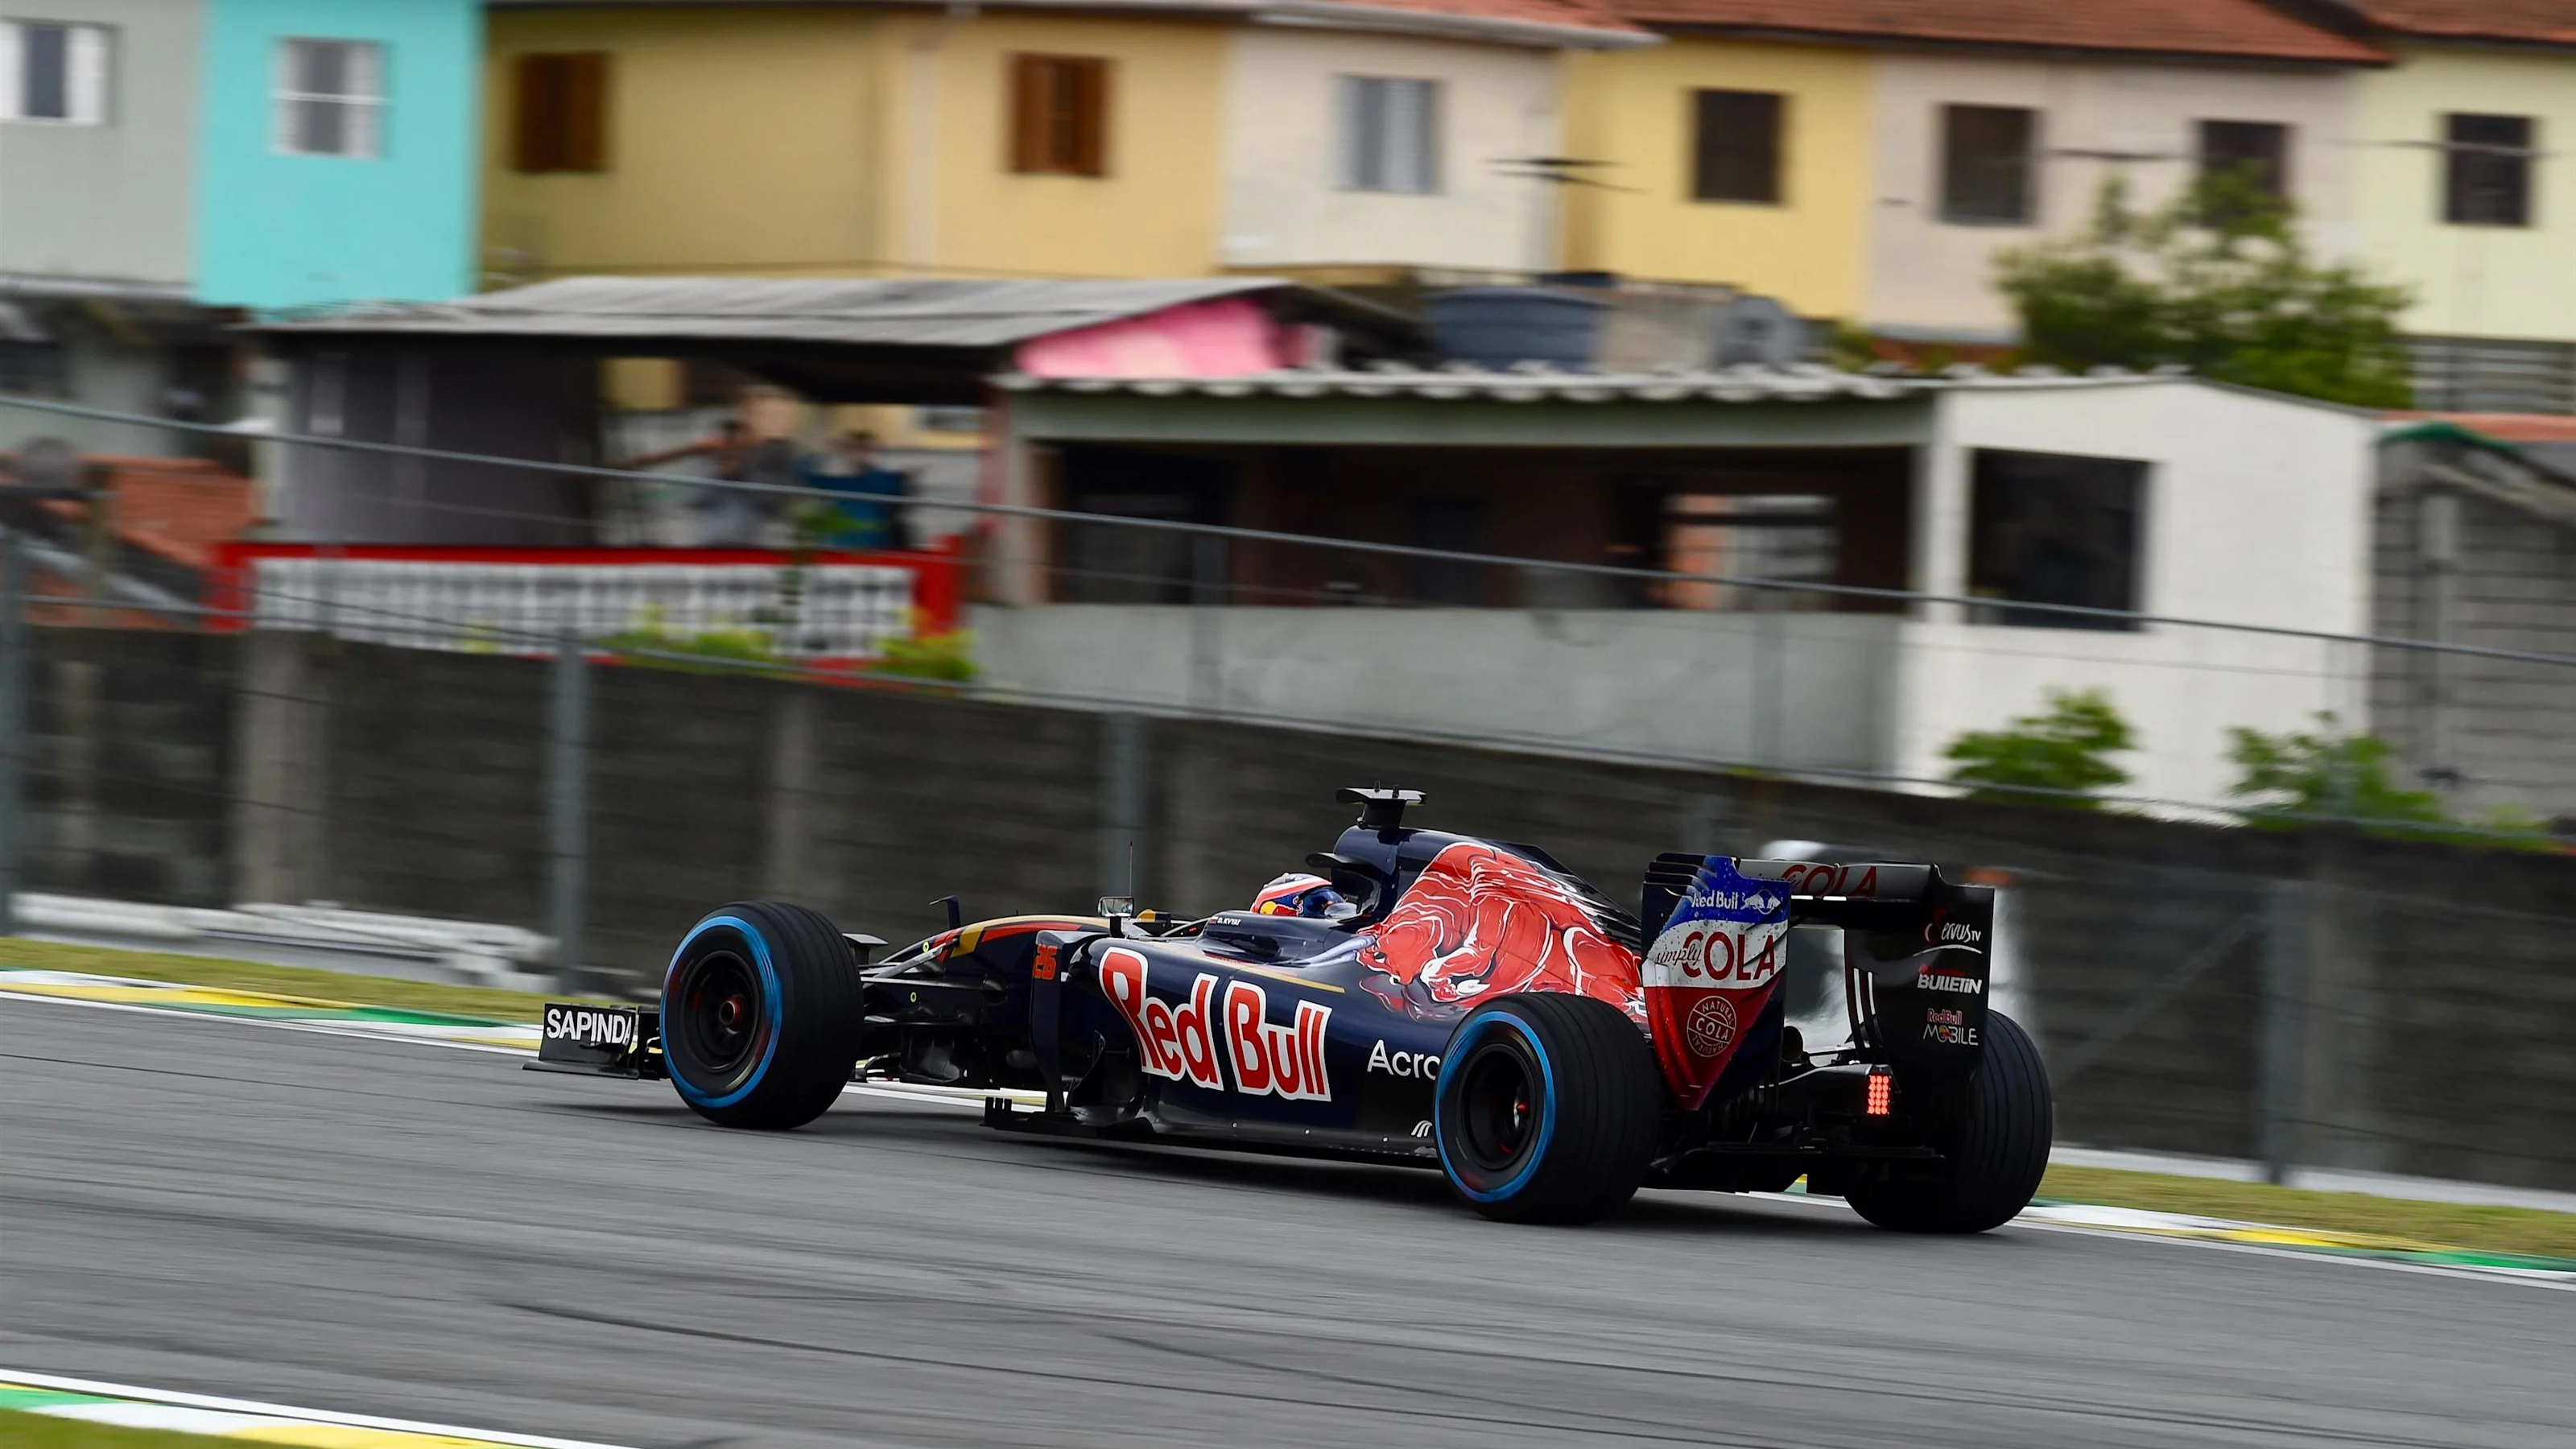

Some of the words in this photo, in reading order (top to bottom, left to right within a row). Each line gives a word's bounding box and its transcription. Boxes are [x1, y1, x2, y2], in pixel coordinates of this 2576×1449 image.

[1715, 891, 1739, 910] Bull
[1033, 943, 1057, 980] 26
[1654, 943, 1702, 966] simply
[1681, 931, 1776, 980] COLA
[547, 1008, 632, 1046] SAPINDA
[1100, 947, 1224, 1091] Red
[1223, 980, 1332, 1102] Bull
[1695, 1017, 1729, 1041] COLA
[1702, 1001, 1735, 1026] NATURAL
[1922, 1023, 1979, 1046] MOBILE
